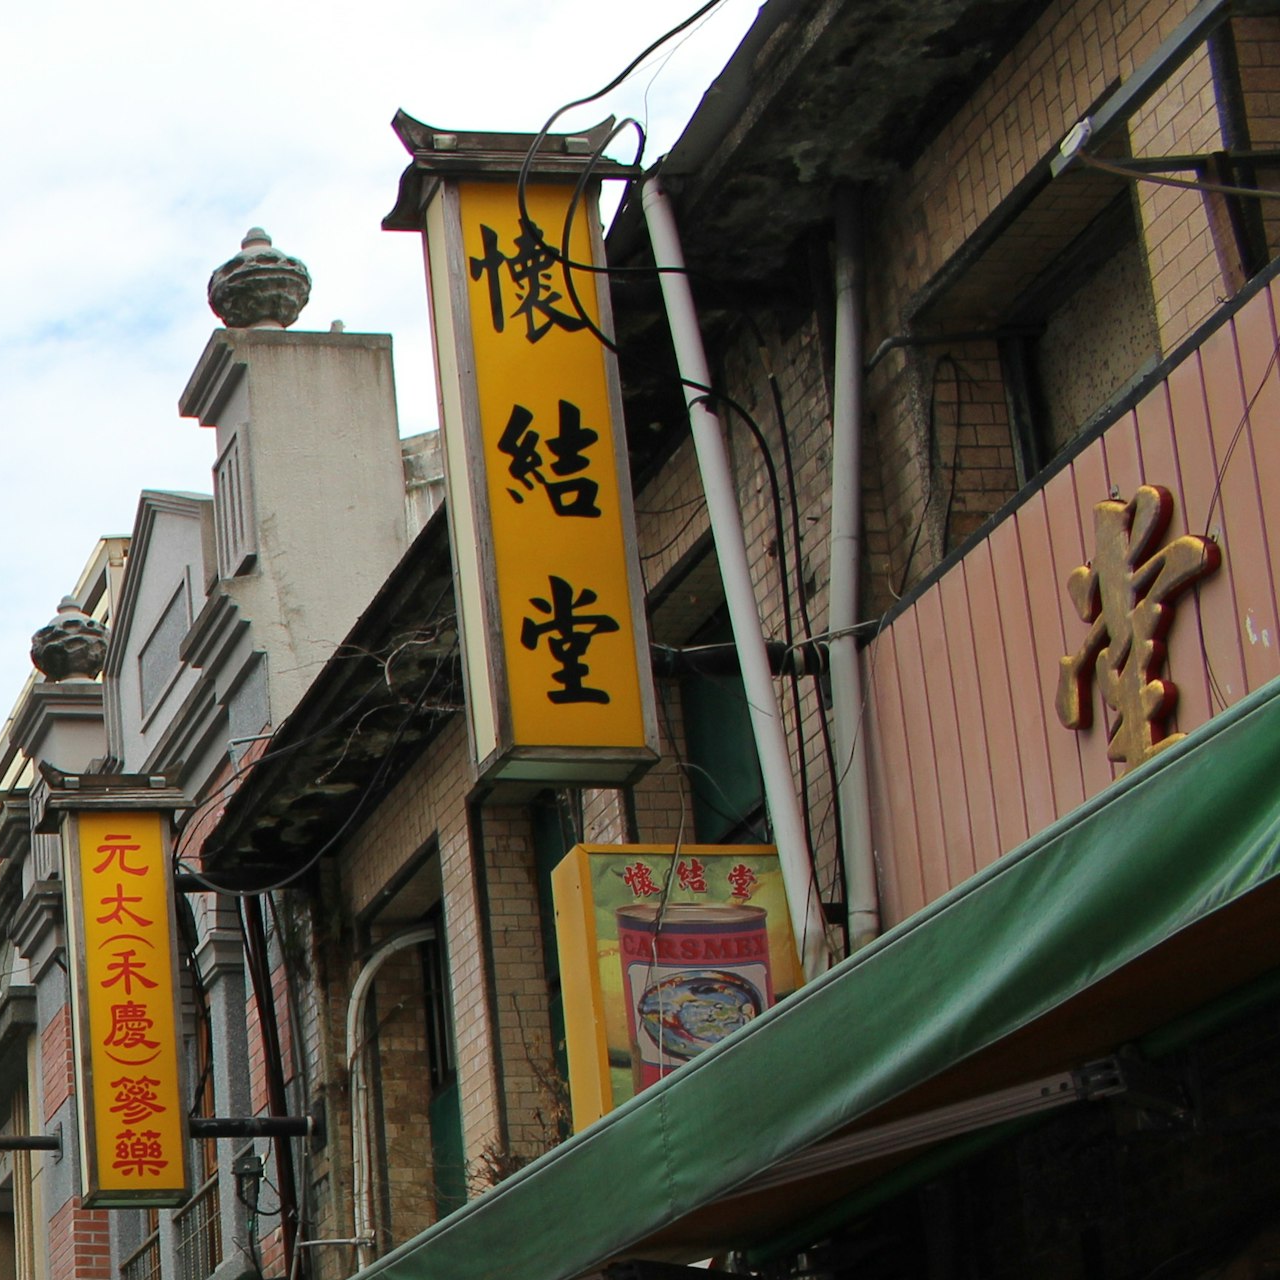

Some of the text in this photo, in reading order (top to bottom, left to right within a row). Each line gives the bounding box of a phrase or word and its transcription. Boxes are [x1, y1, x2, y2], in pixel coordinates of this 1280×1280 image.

[469, 217, 619, 705] 懷結堂
[623, 858, 758, 900] 懷結堂
